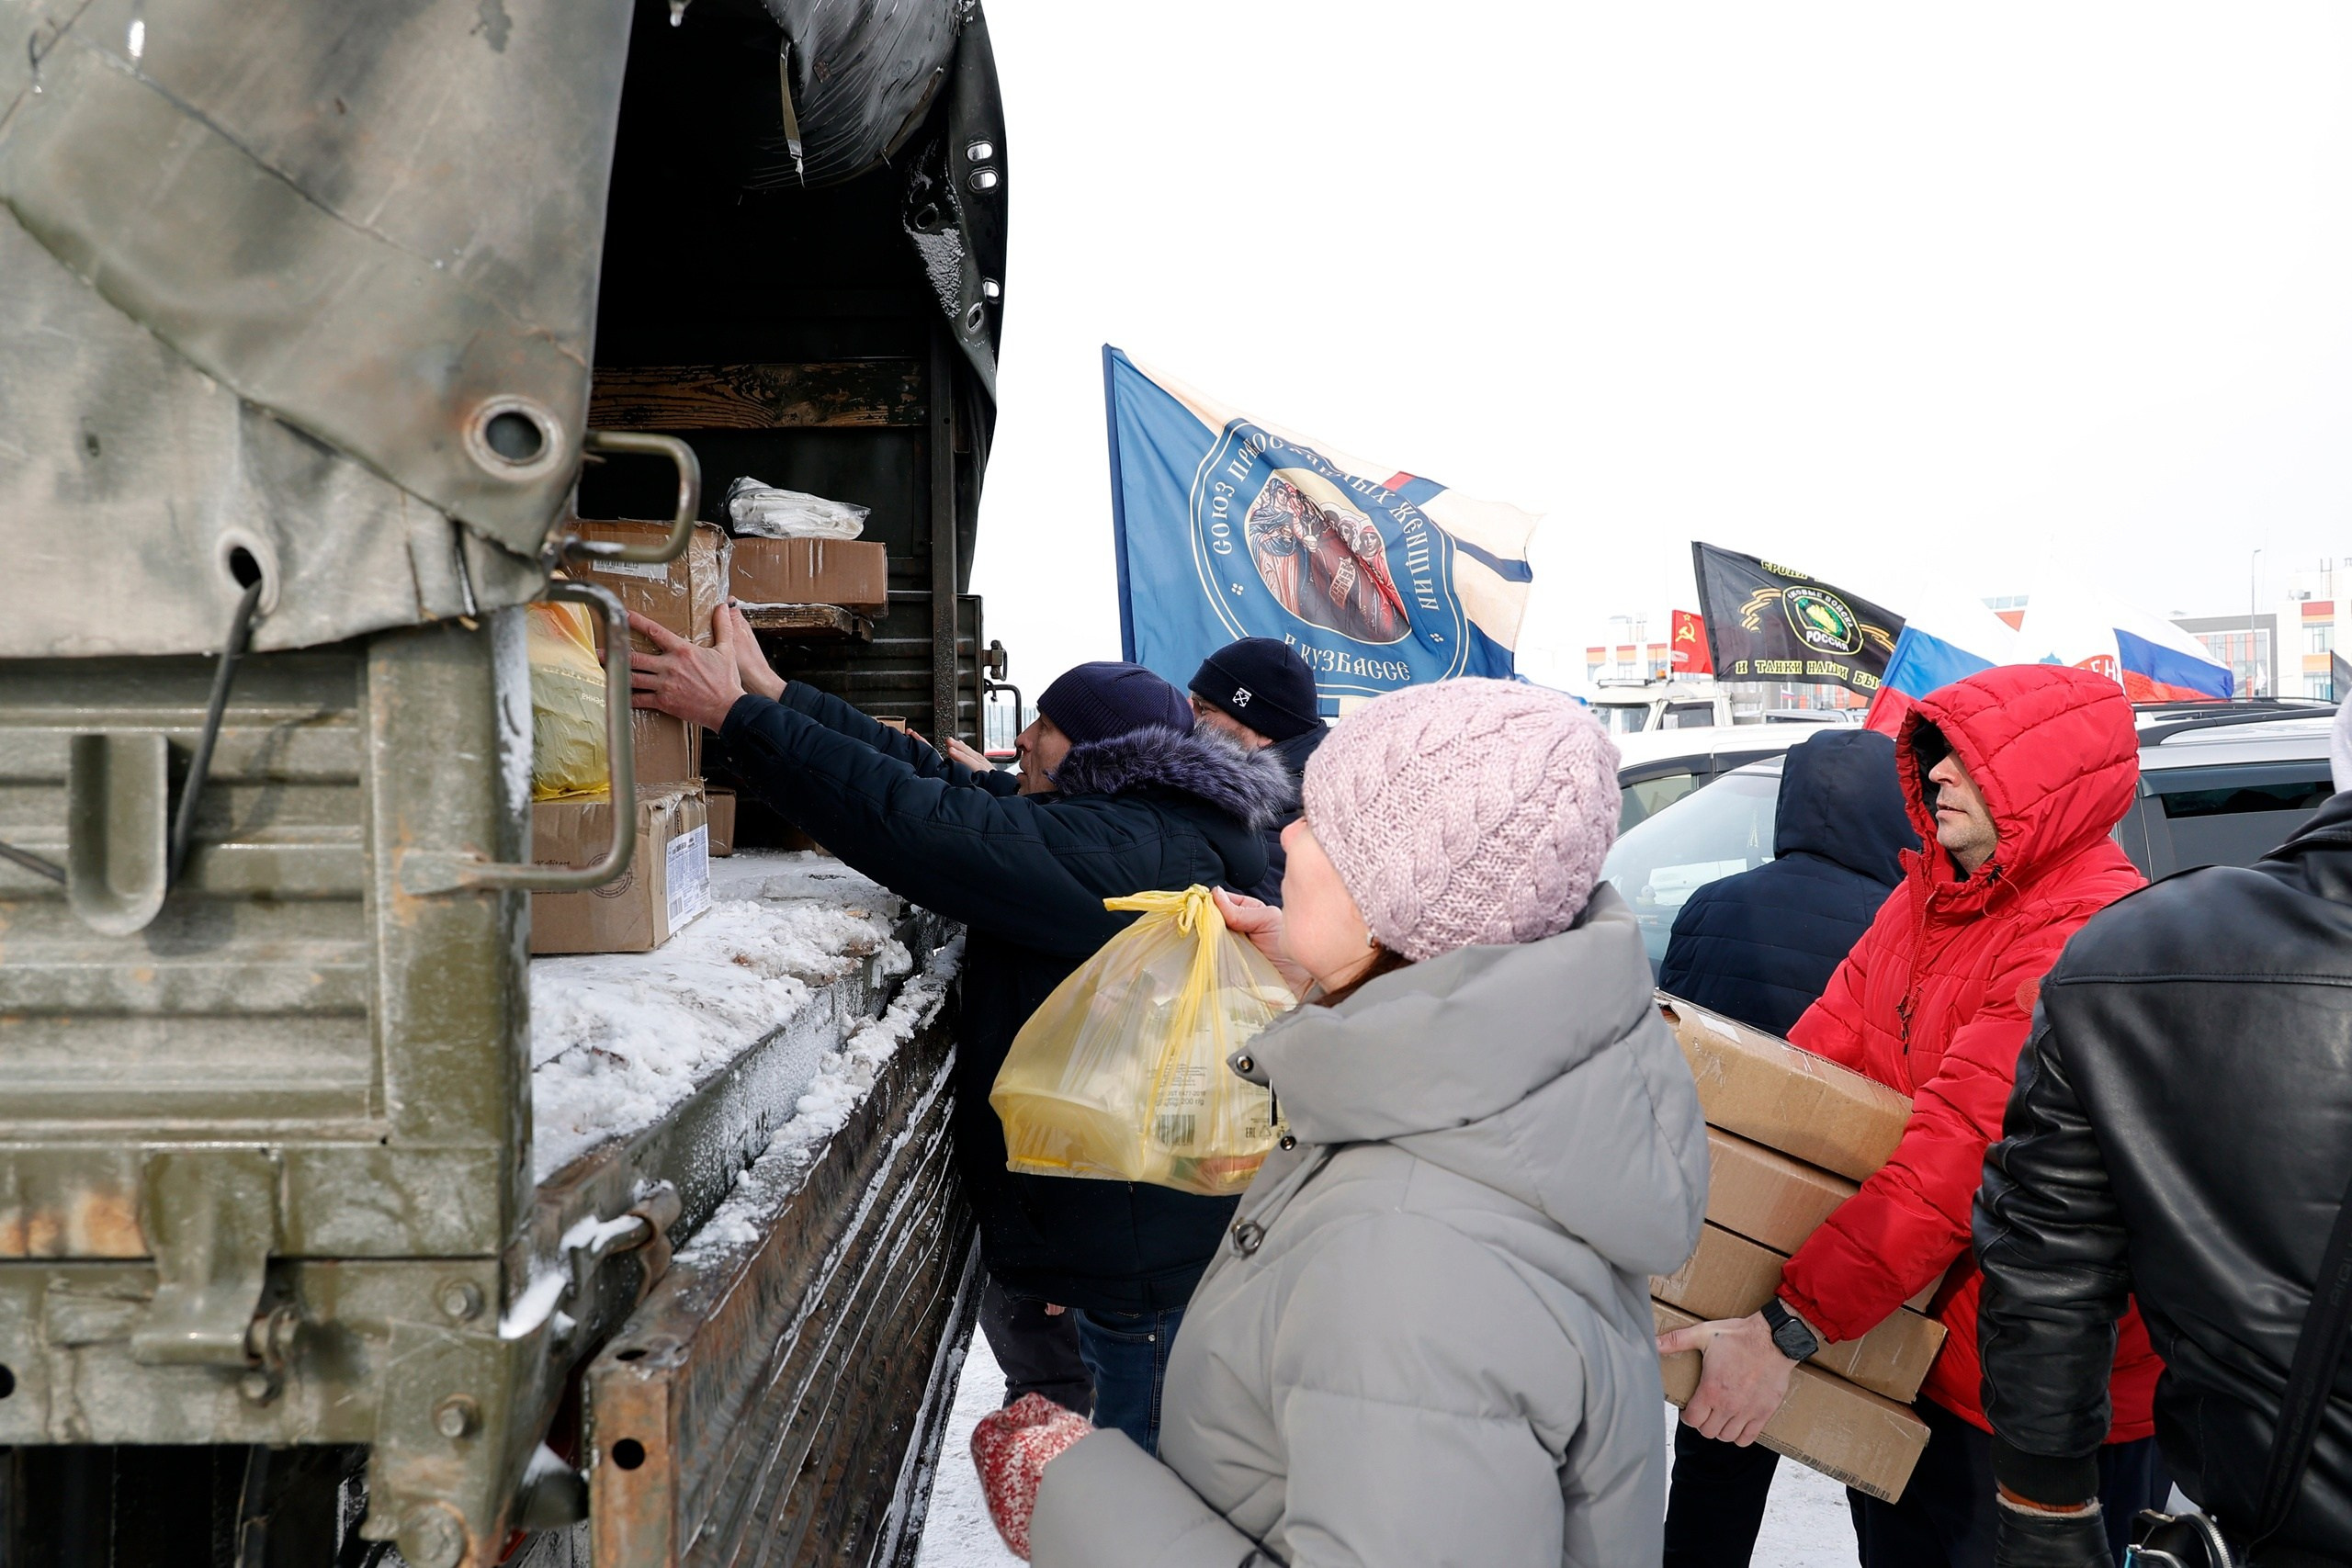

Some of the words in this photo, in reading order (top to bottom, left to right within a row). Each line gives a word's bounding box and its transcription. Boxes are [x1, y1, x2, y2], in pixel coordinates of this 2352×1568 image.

[1211, 481, 1235, 555] СОЮЗ
[1389, 502, 1440, 611] ЖЕНЩИН
[1806, 630, 1849, 651] РОССИЯ
[1300, 643, 1410, 681] КУЗБАССЕ
[1736, 660, 1748, 674] И
[1755, 660, 1803, 674] ТАНКИ
[1806, 660, 1849, 681] НАШИ
[1852, 670, 1883, 690] БЫ
